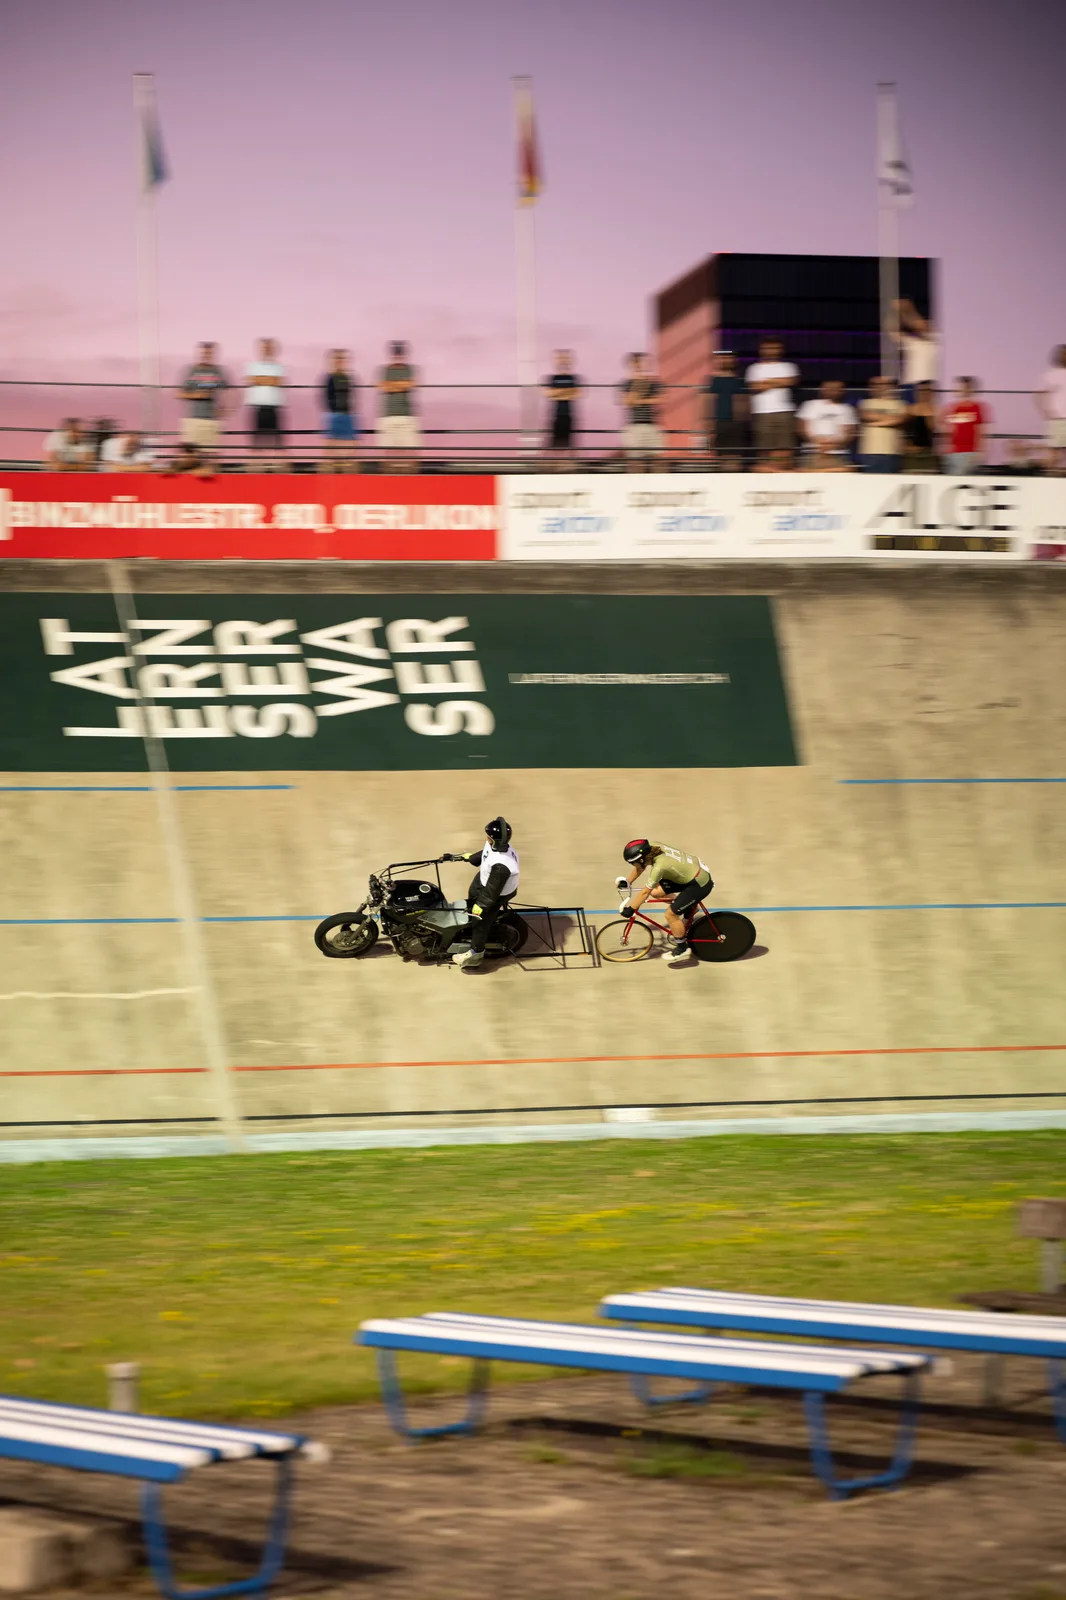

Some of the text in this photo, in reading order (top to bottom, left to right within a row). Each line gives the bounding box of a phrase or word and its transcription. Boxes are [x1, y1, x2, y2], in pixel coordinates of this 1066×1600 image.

[332, 504, 500, 531] OERLIKON
[866, 483, 1020, 531] ALGE
[213, 619, 317, 739] SER
[386, 616, 495, 737] SER
